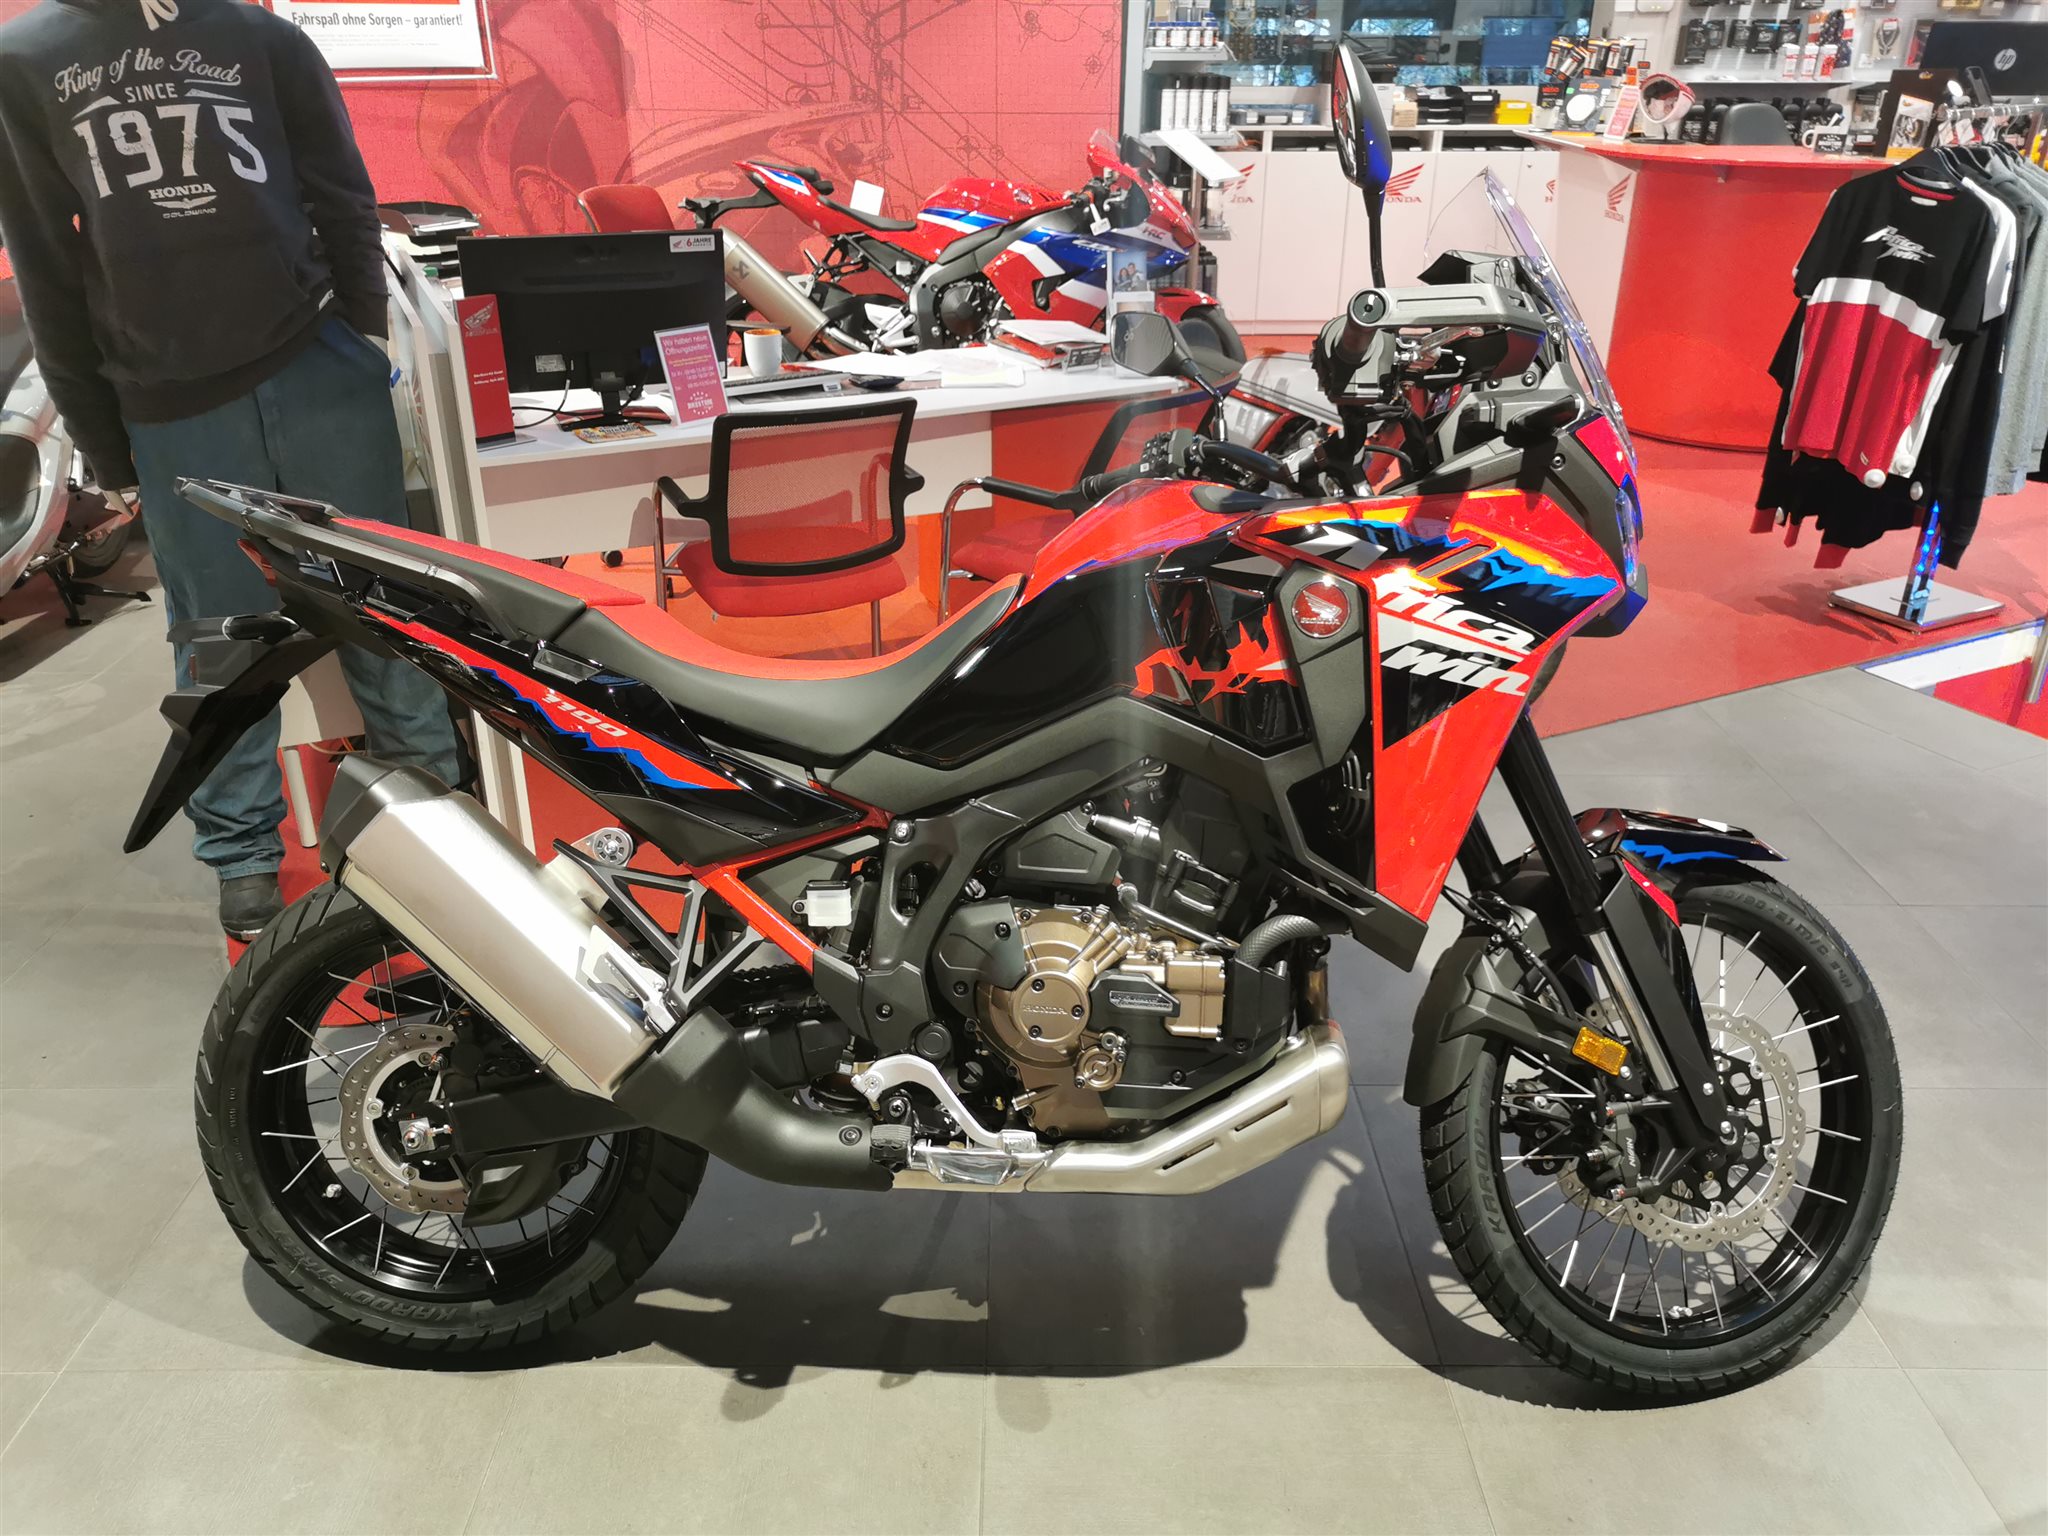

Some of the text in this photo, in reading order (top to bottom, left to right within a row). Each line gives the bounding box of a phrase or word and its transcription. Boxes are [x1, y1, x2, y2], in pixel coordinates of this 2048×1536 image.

[291, 12, 340, 28] Fahrspaß
[342, 16, 366, 26] ohne
[369, 14, 403, 28] Sorgen
[413, 13, 463, 28] garantiert!
[55, 47, 241, 103] King of the Road
[124, 82, 178, 104] SINCE
[73, 103, 268, 199] 1975
[148, 183, 217, 200] HONDA
[541, 693, 629, 737] 1100
